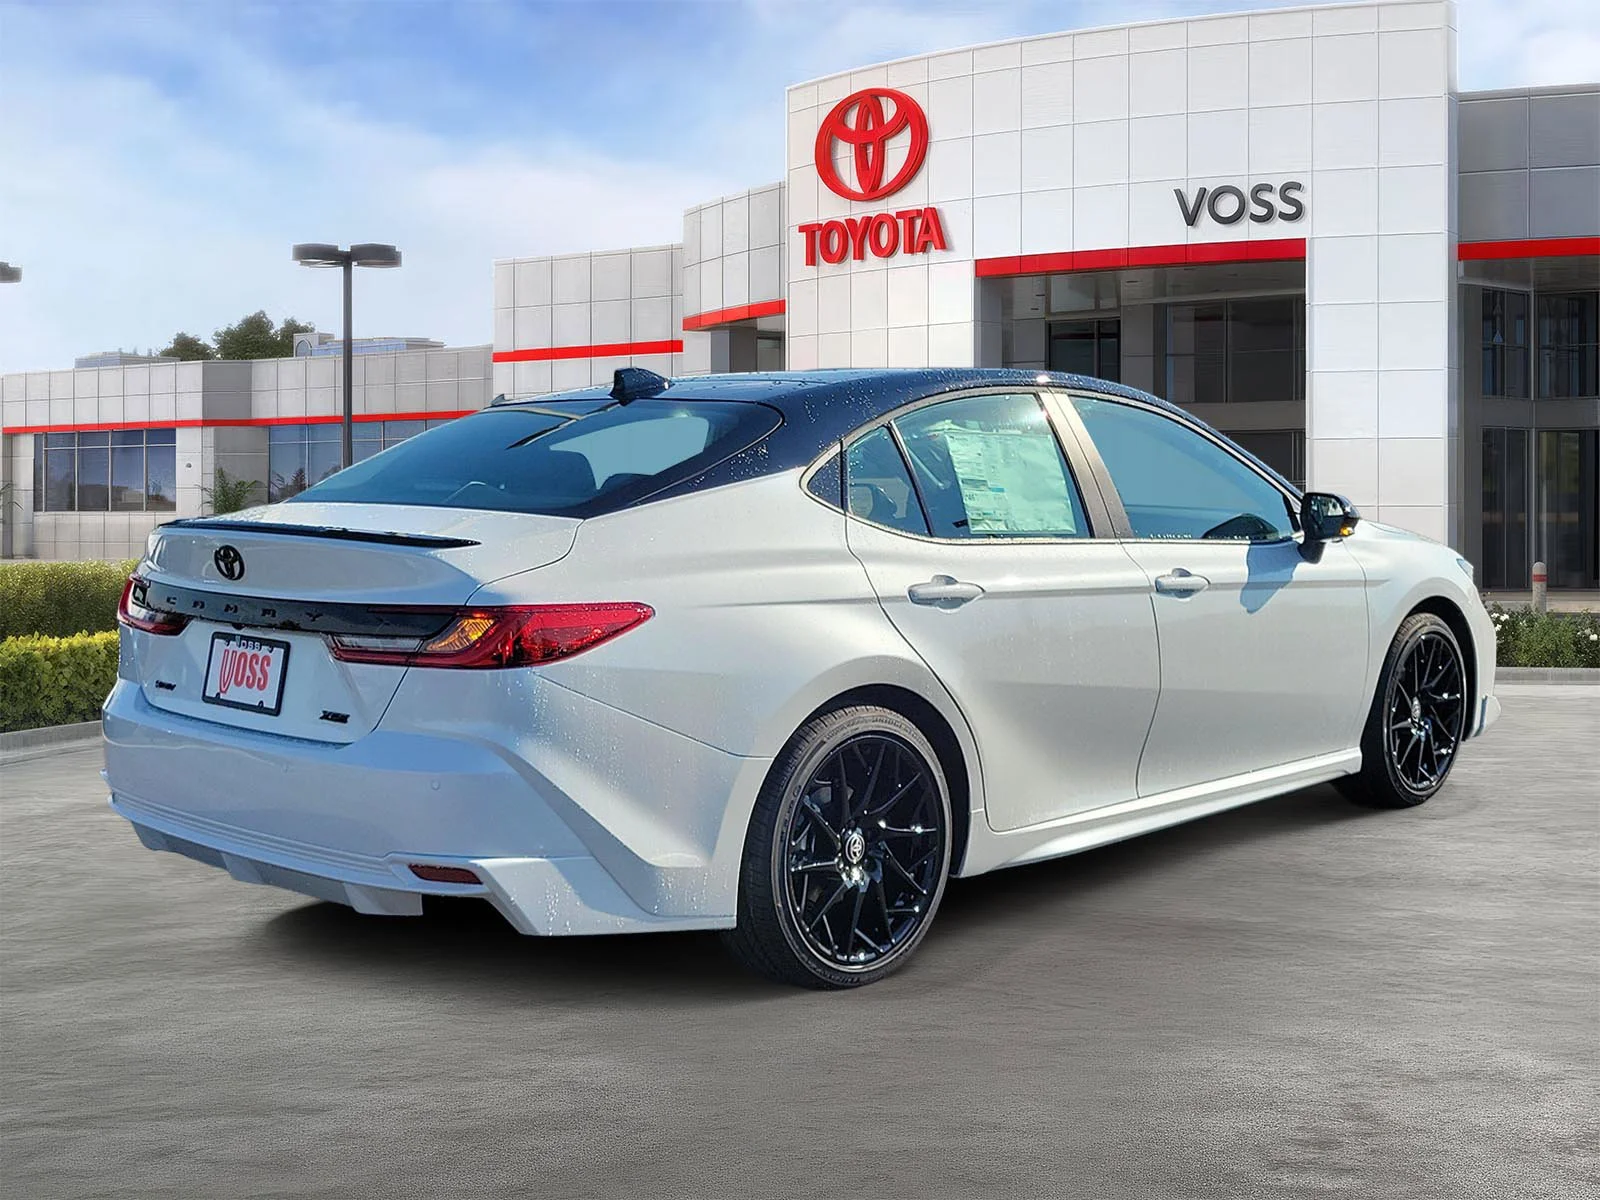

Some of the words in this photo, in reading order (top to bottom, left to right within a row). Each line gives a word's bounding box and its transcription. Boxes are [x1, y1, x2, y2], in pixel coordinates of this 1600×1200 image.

[1173, 181, 1304, 226] VOSS
[798, 207, 948, 266] TOYOTA
[166, 596, 323, 622] CAMRY
[219, 648, 272, 694] VOSS
